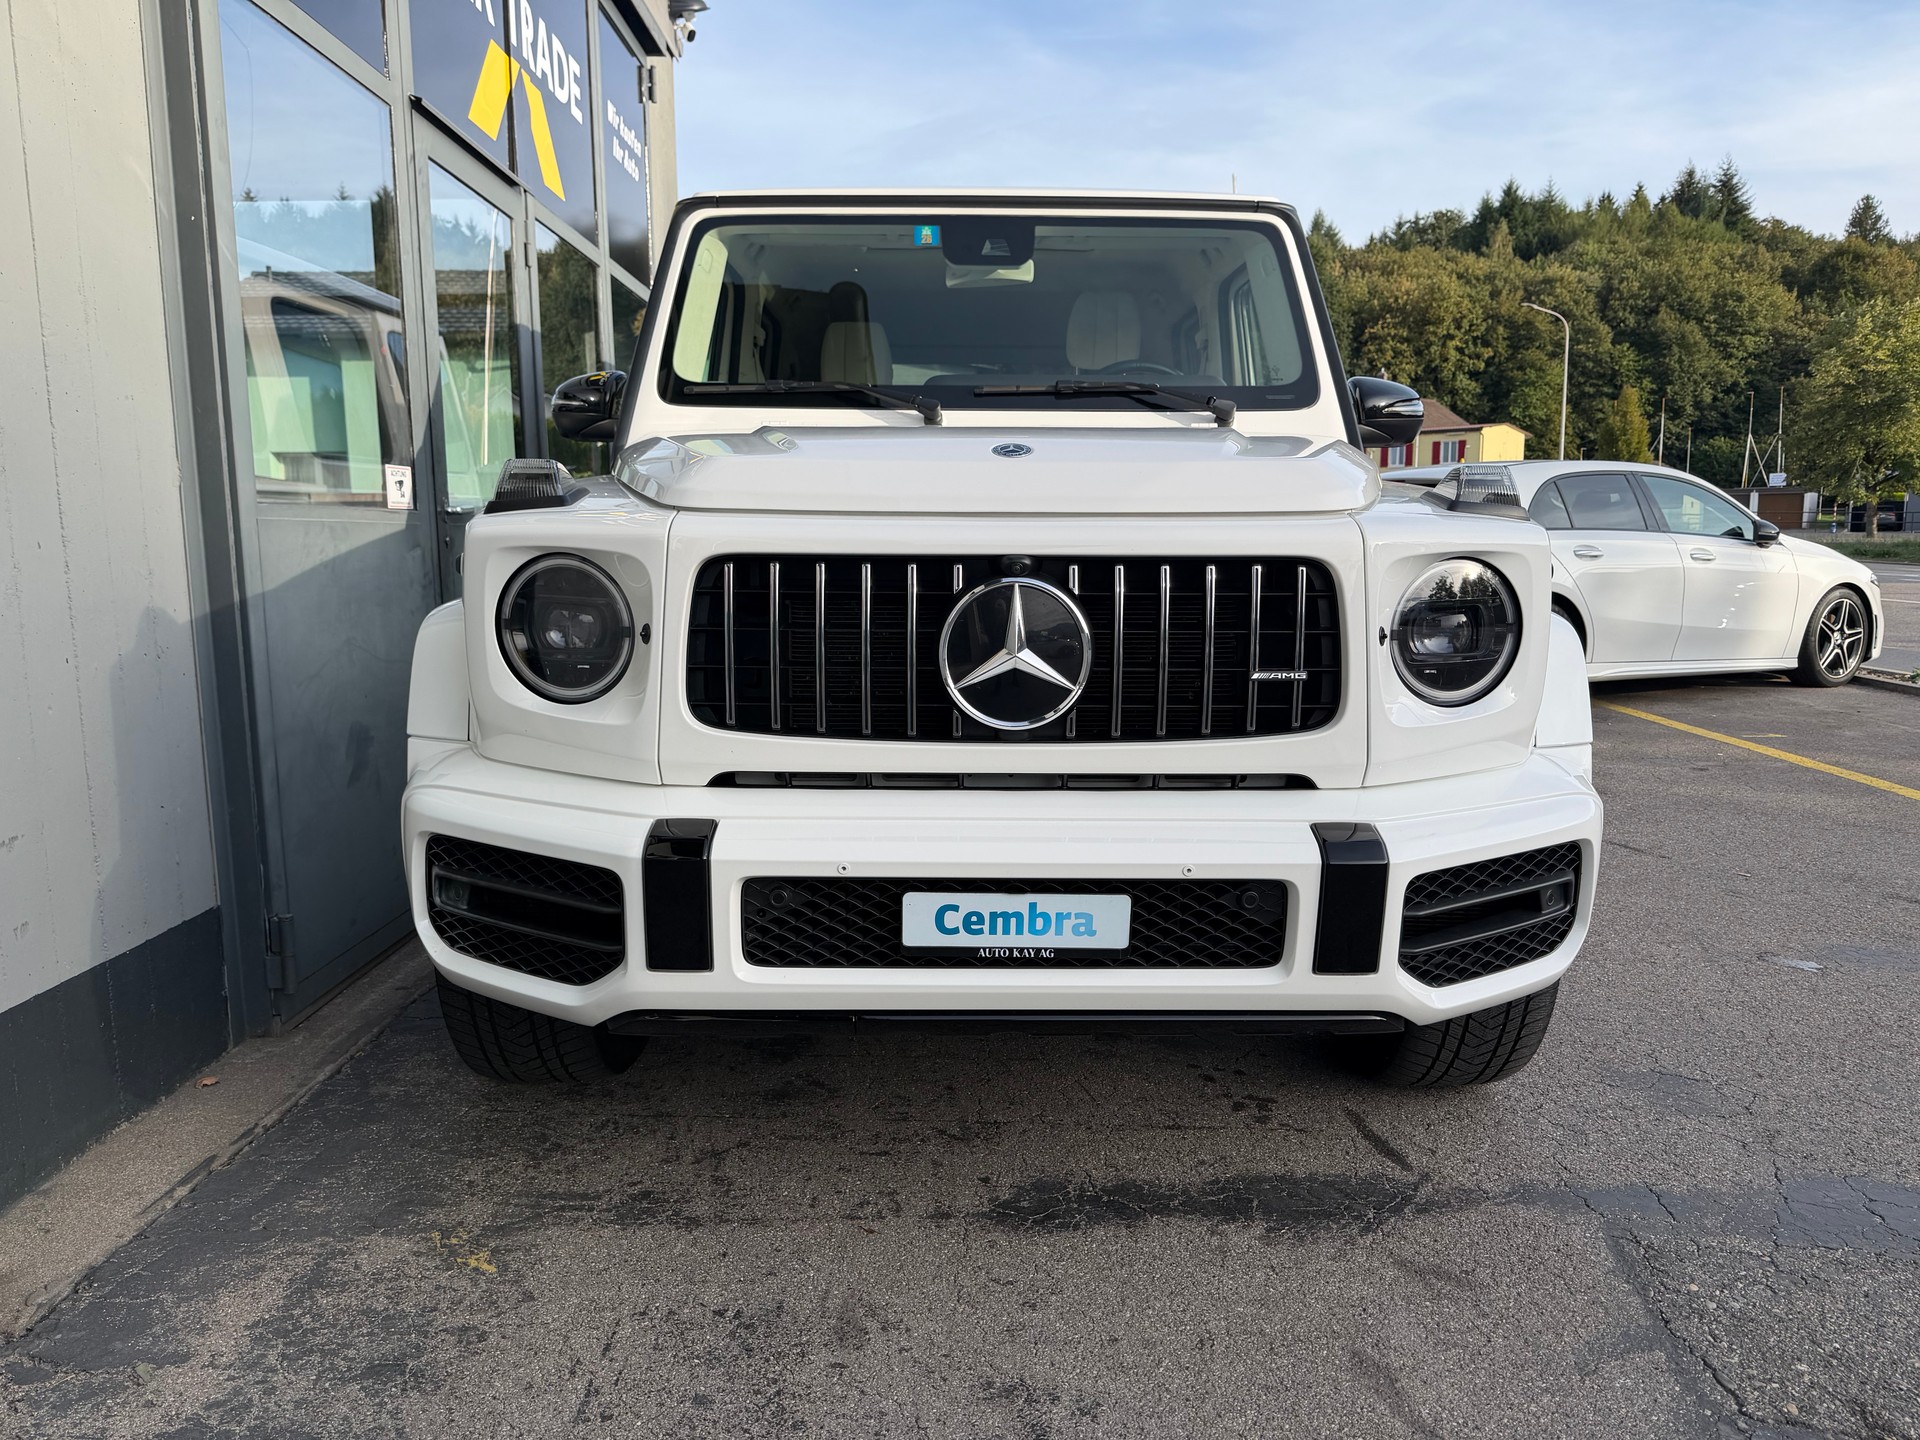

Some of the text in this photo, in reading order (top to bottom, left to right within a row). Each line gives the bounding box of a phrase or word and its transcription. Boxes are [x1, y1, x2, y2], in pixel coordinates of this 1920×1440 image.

[508, 0, 583, 125] TRADE
[607, 99, 620, 131] Wir
[612, 135, 624, 164] Ihr
[934, 901, 1097, 937] Cembra
[977, 948, 1055, 958] AUTO KAY AG
